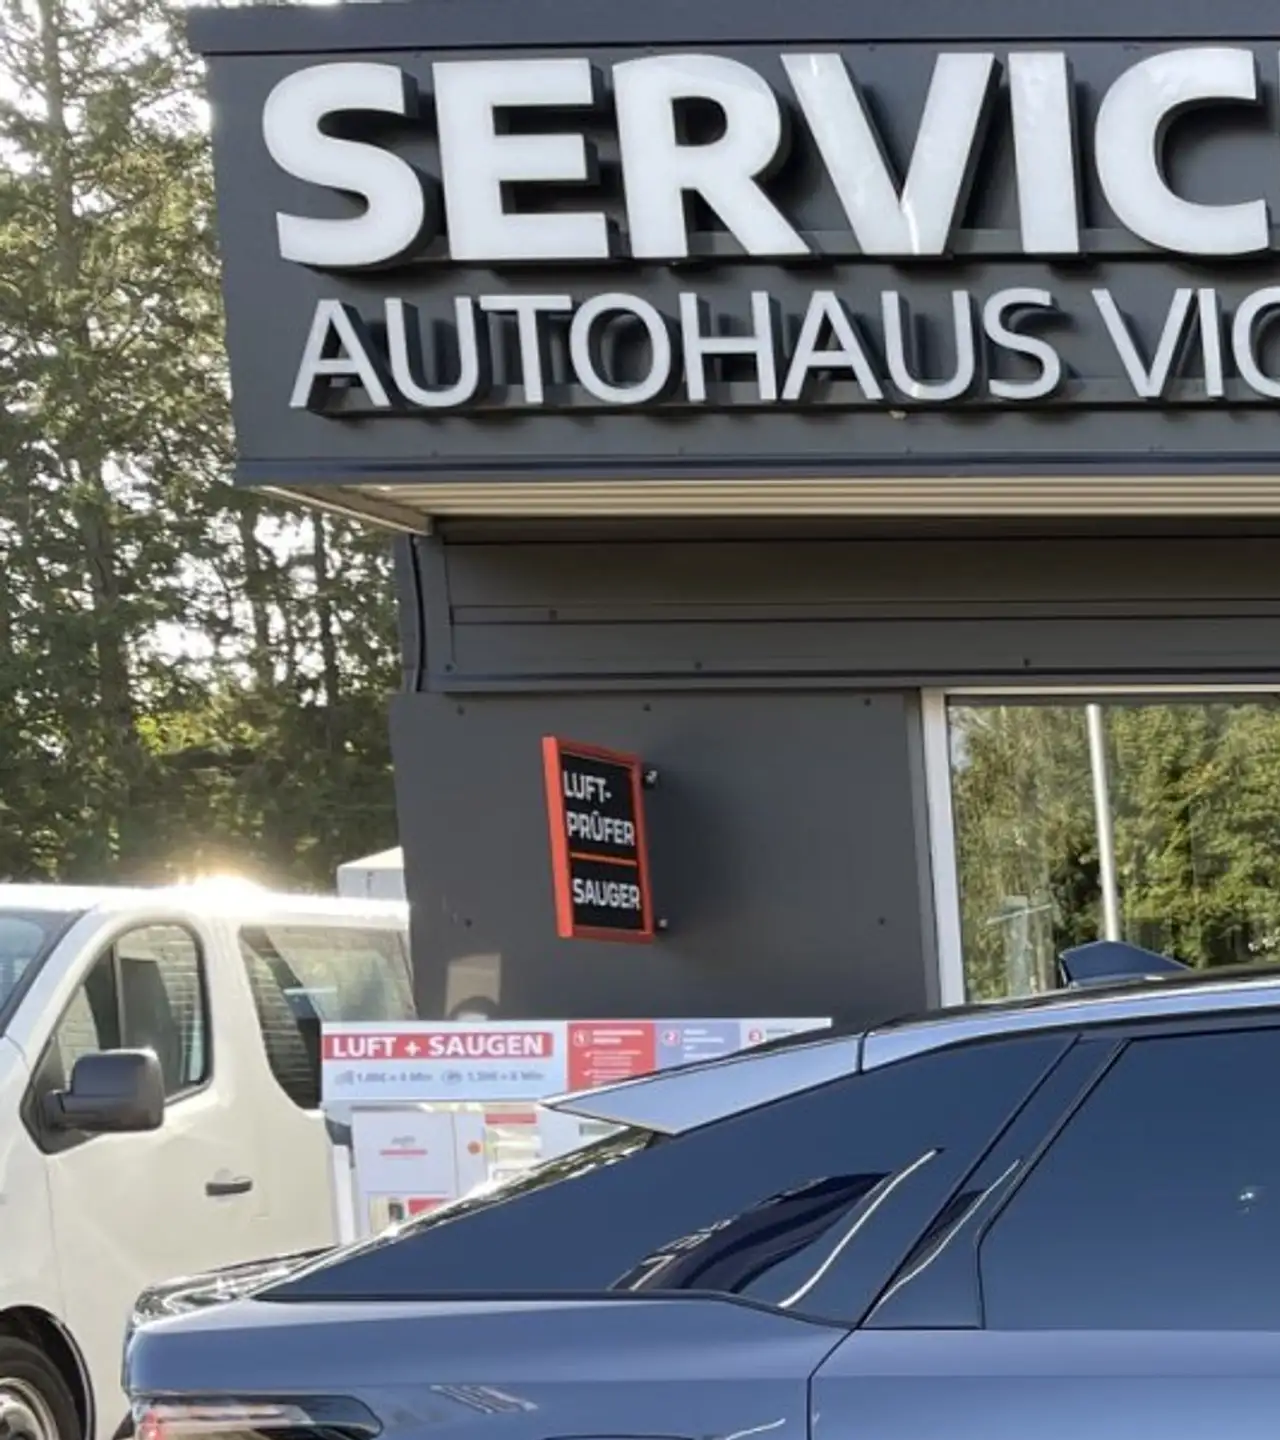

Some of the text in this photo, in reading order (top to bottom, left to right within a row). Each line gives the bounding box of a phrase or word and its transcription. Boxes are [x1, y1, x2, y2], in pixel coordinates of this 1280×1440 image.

[288, 287, 1064, 412] AUTOHAUS
[562, 770, 613, 803] LUFT-
[566, 810, 635, 847] PRÜFER
[571, 877, 641, 910] SAUGER
[332, 1034, 544, 1058] LUFT + SAUGEN
